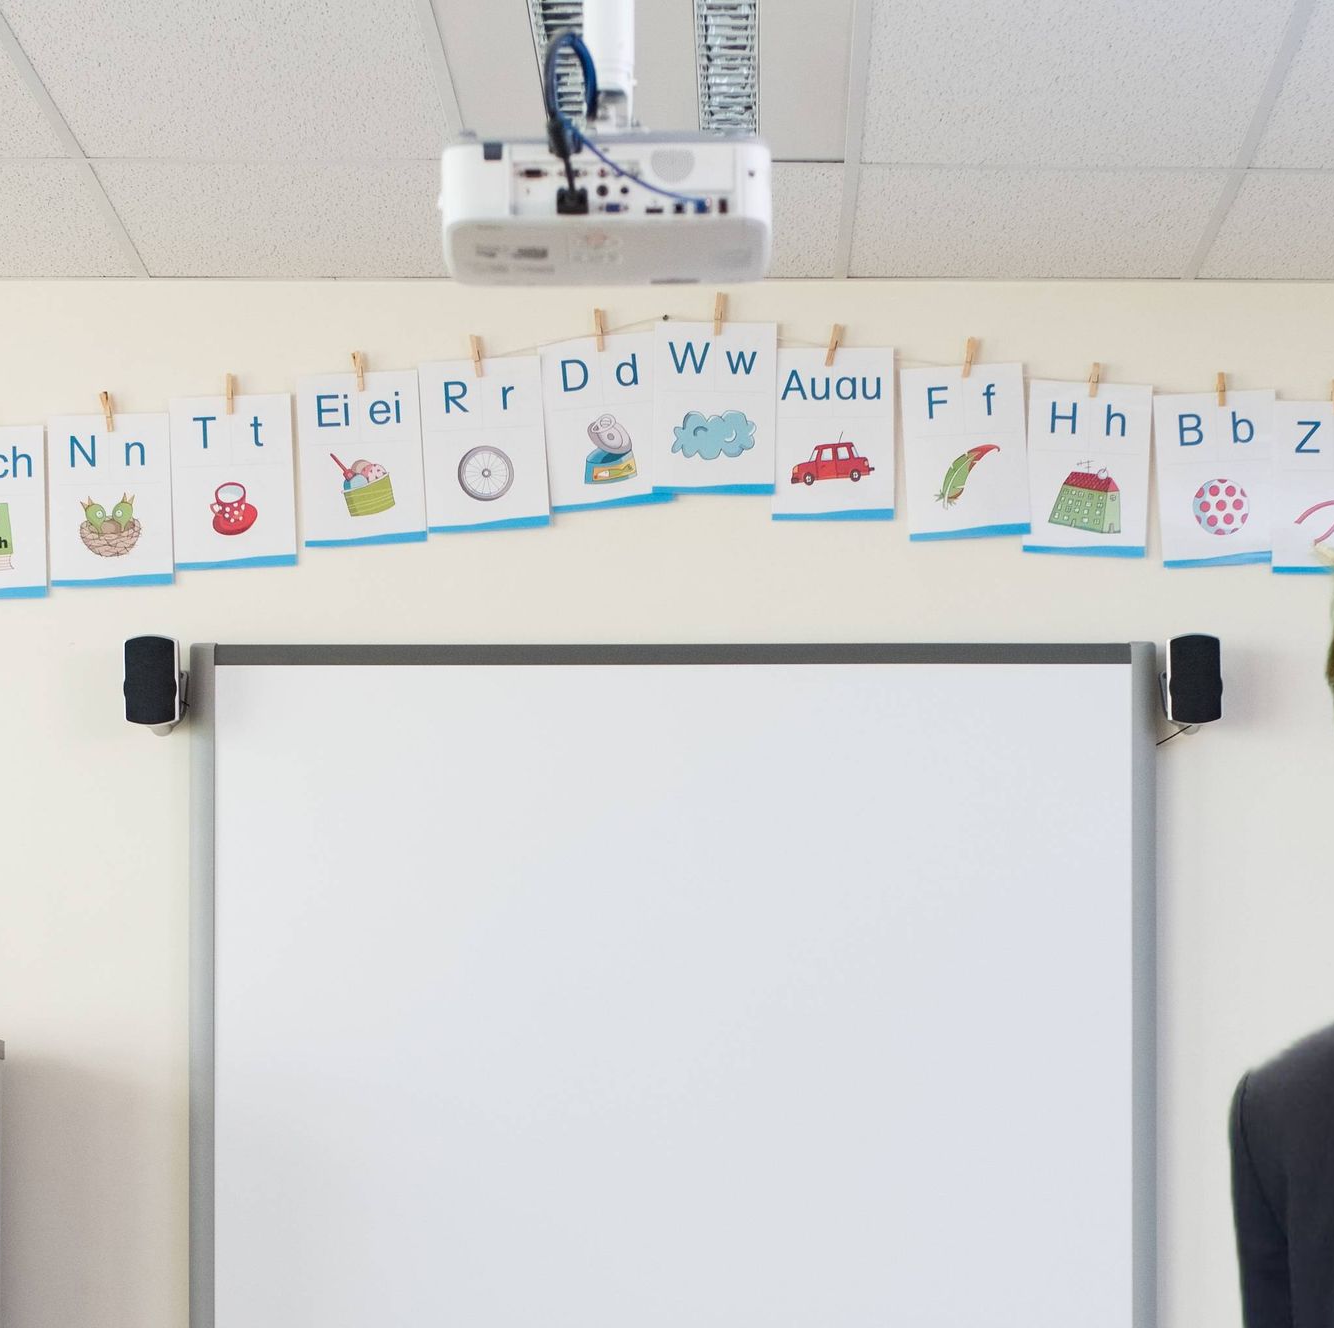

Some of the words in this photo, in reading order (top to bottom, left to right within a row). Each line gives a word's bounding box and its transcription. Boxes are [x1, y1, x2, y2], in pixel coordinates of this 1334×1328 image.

[561, 359, 588, 392] D
[615, 353, 639, 387] d
[668, 342, 710, 374] W
[726, 352, 757, 375] w
[444, 381, 468, 413] R
[501, 385, 514, 410] r
[927, 386, 948, 419] F
[983, 384, 995, 416] f
[193, 416, 216, 449] T
[250, 416, 263, 447] t
[1050, 402, 1077, 434] H
[1106, 404, 1126, 436] h
[1178, 413, 1203, 446] B
[1232, 412, 1254, 443] b
[69, 435, 96, 468] N
[125, 440, 145, 466] n
[1295, 421, 1321, 453] Z
